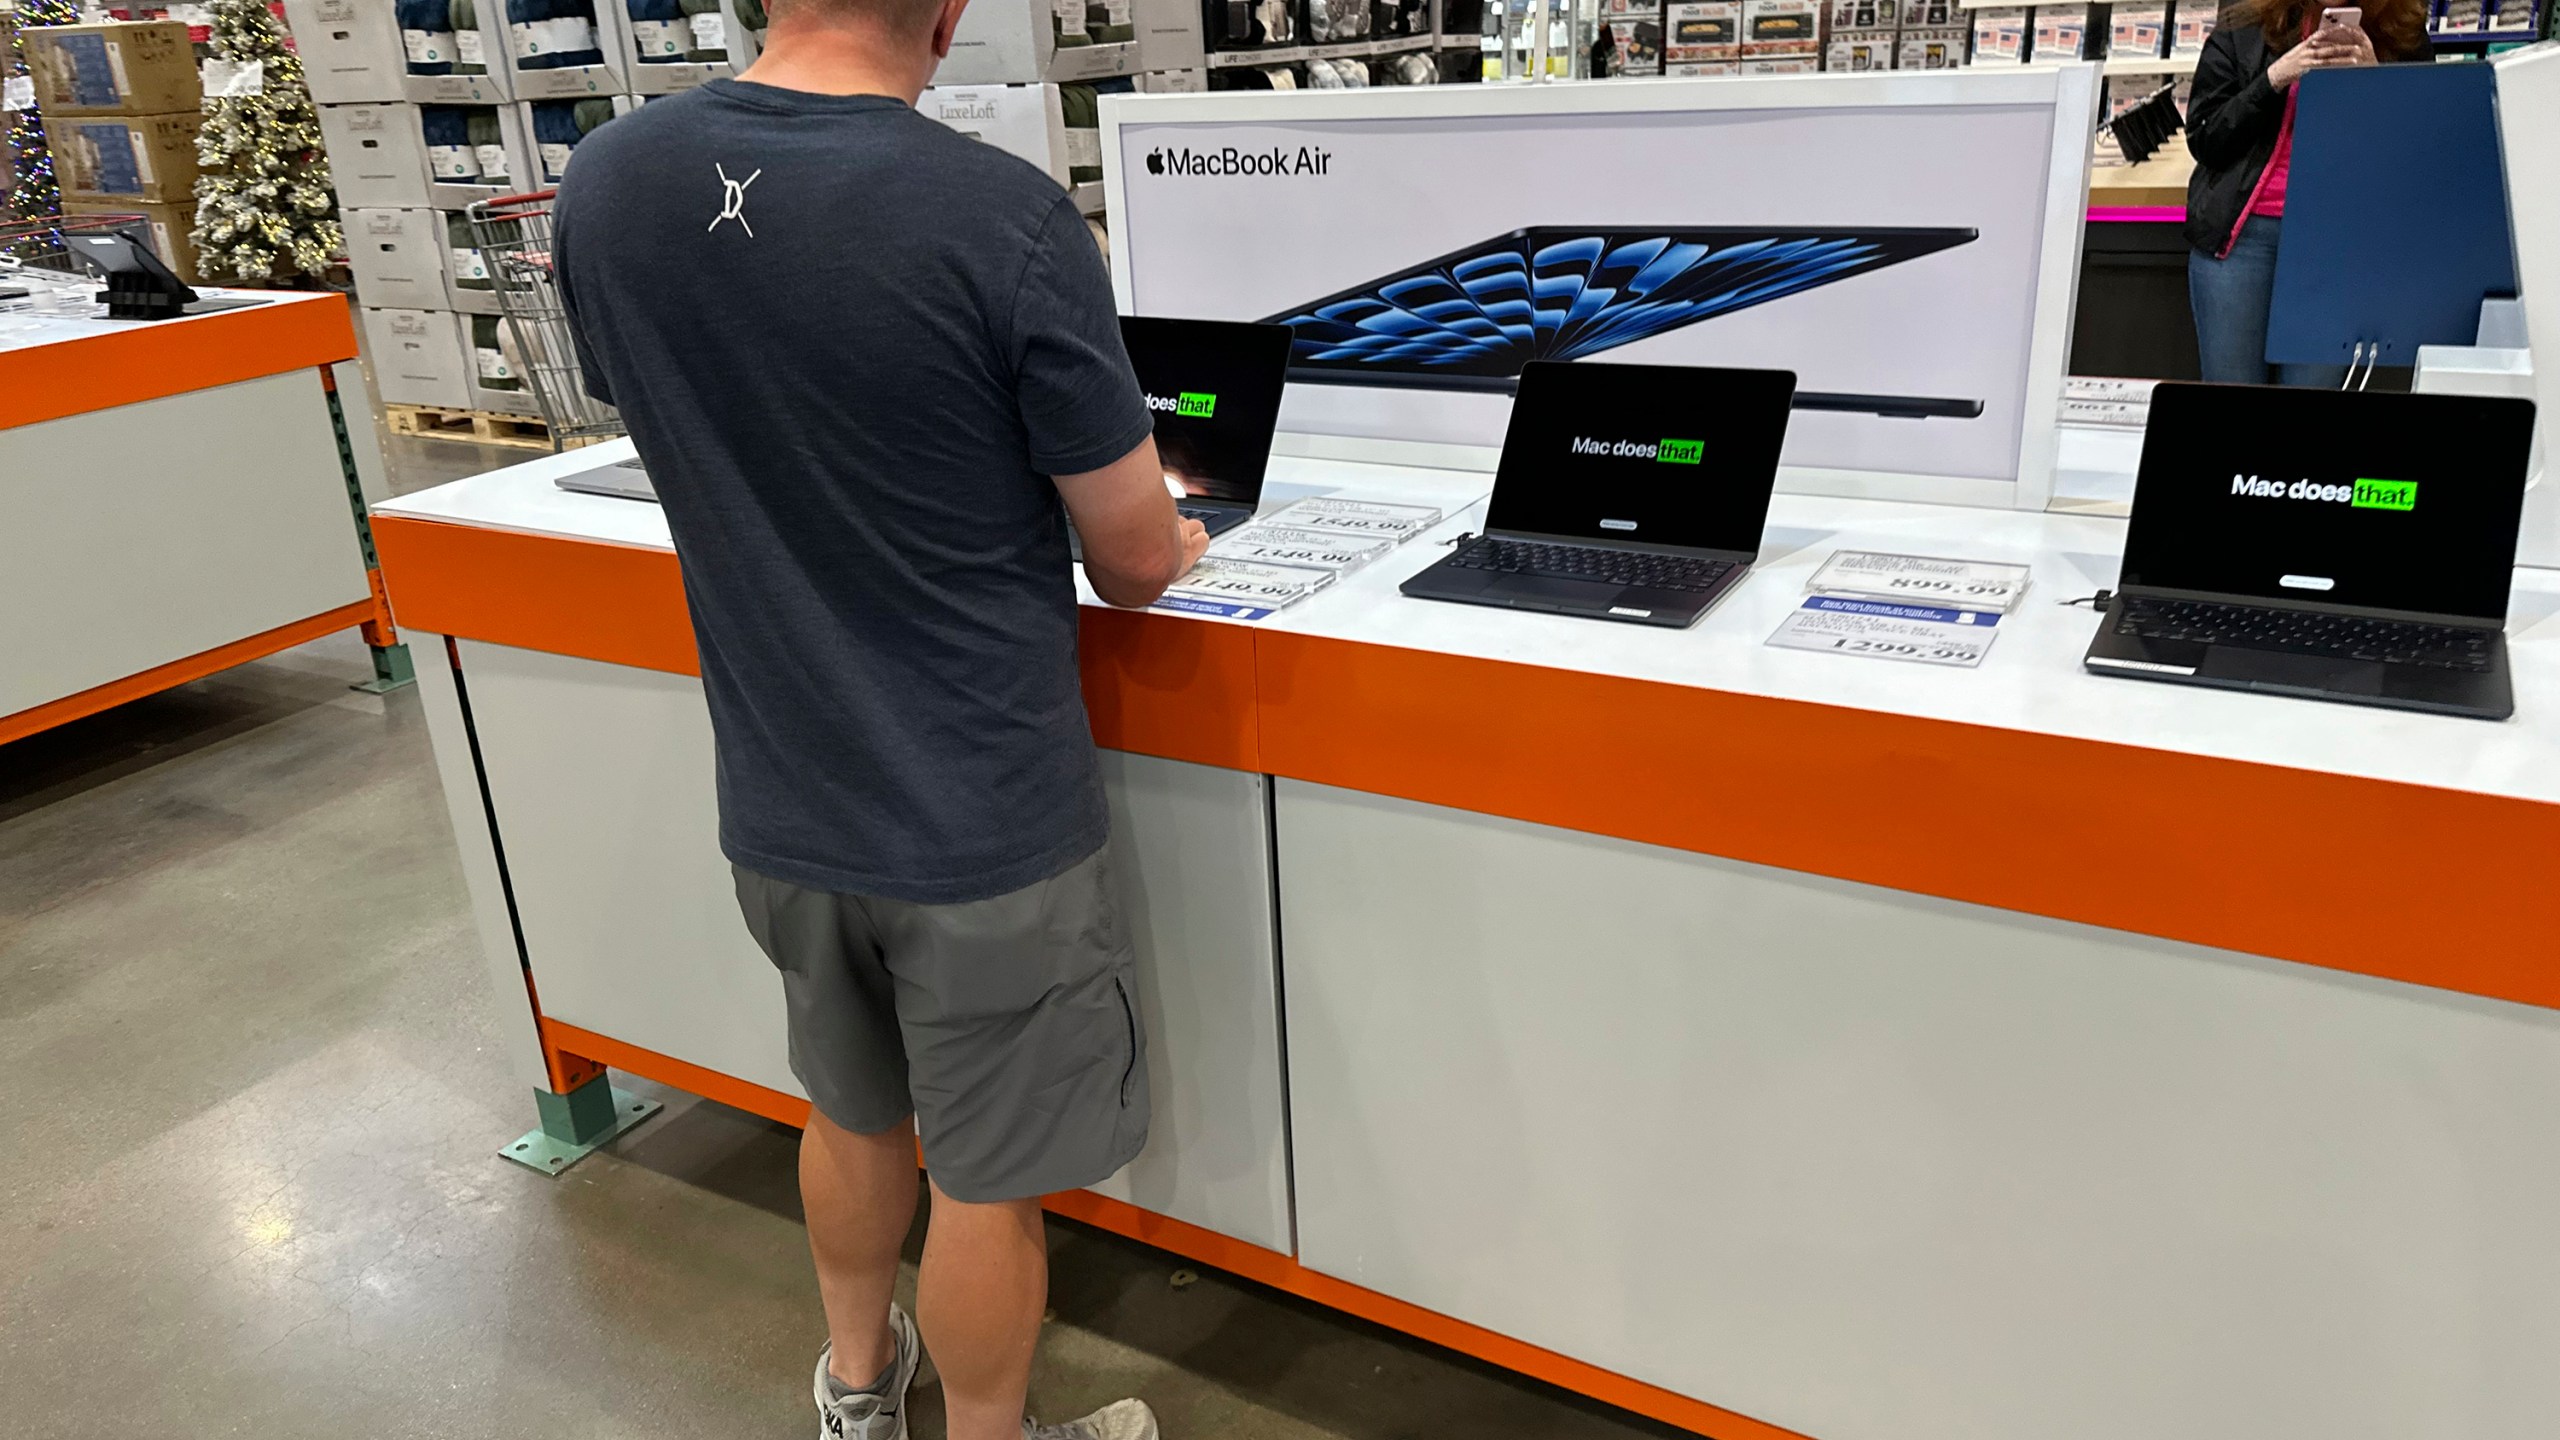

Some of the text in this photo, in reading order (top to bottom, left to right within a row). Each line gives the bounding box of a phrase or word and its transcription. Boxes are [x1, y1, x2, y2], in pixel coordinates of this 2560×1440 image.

[939, 103, 996, 120] LuxeLoft
[1167, 146, 1331, 175] MacBook Air
[1180, 396, 1213, 414] that.
[1572, 436, 1701, 461] Mac does that.
[2231, 474, 2414, 506] Mac does that.
[1889, 578, 2009, 596] 899.99
[1834, 638, 1978, 661] 1299.99
